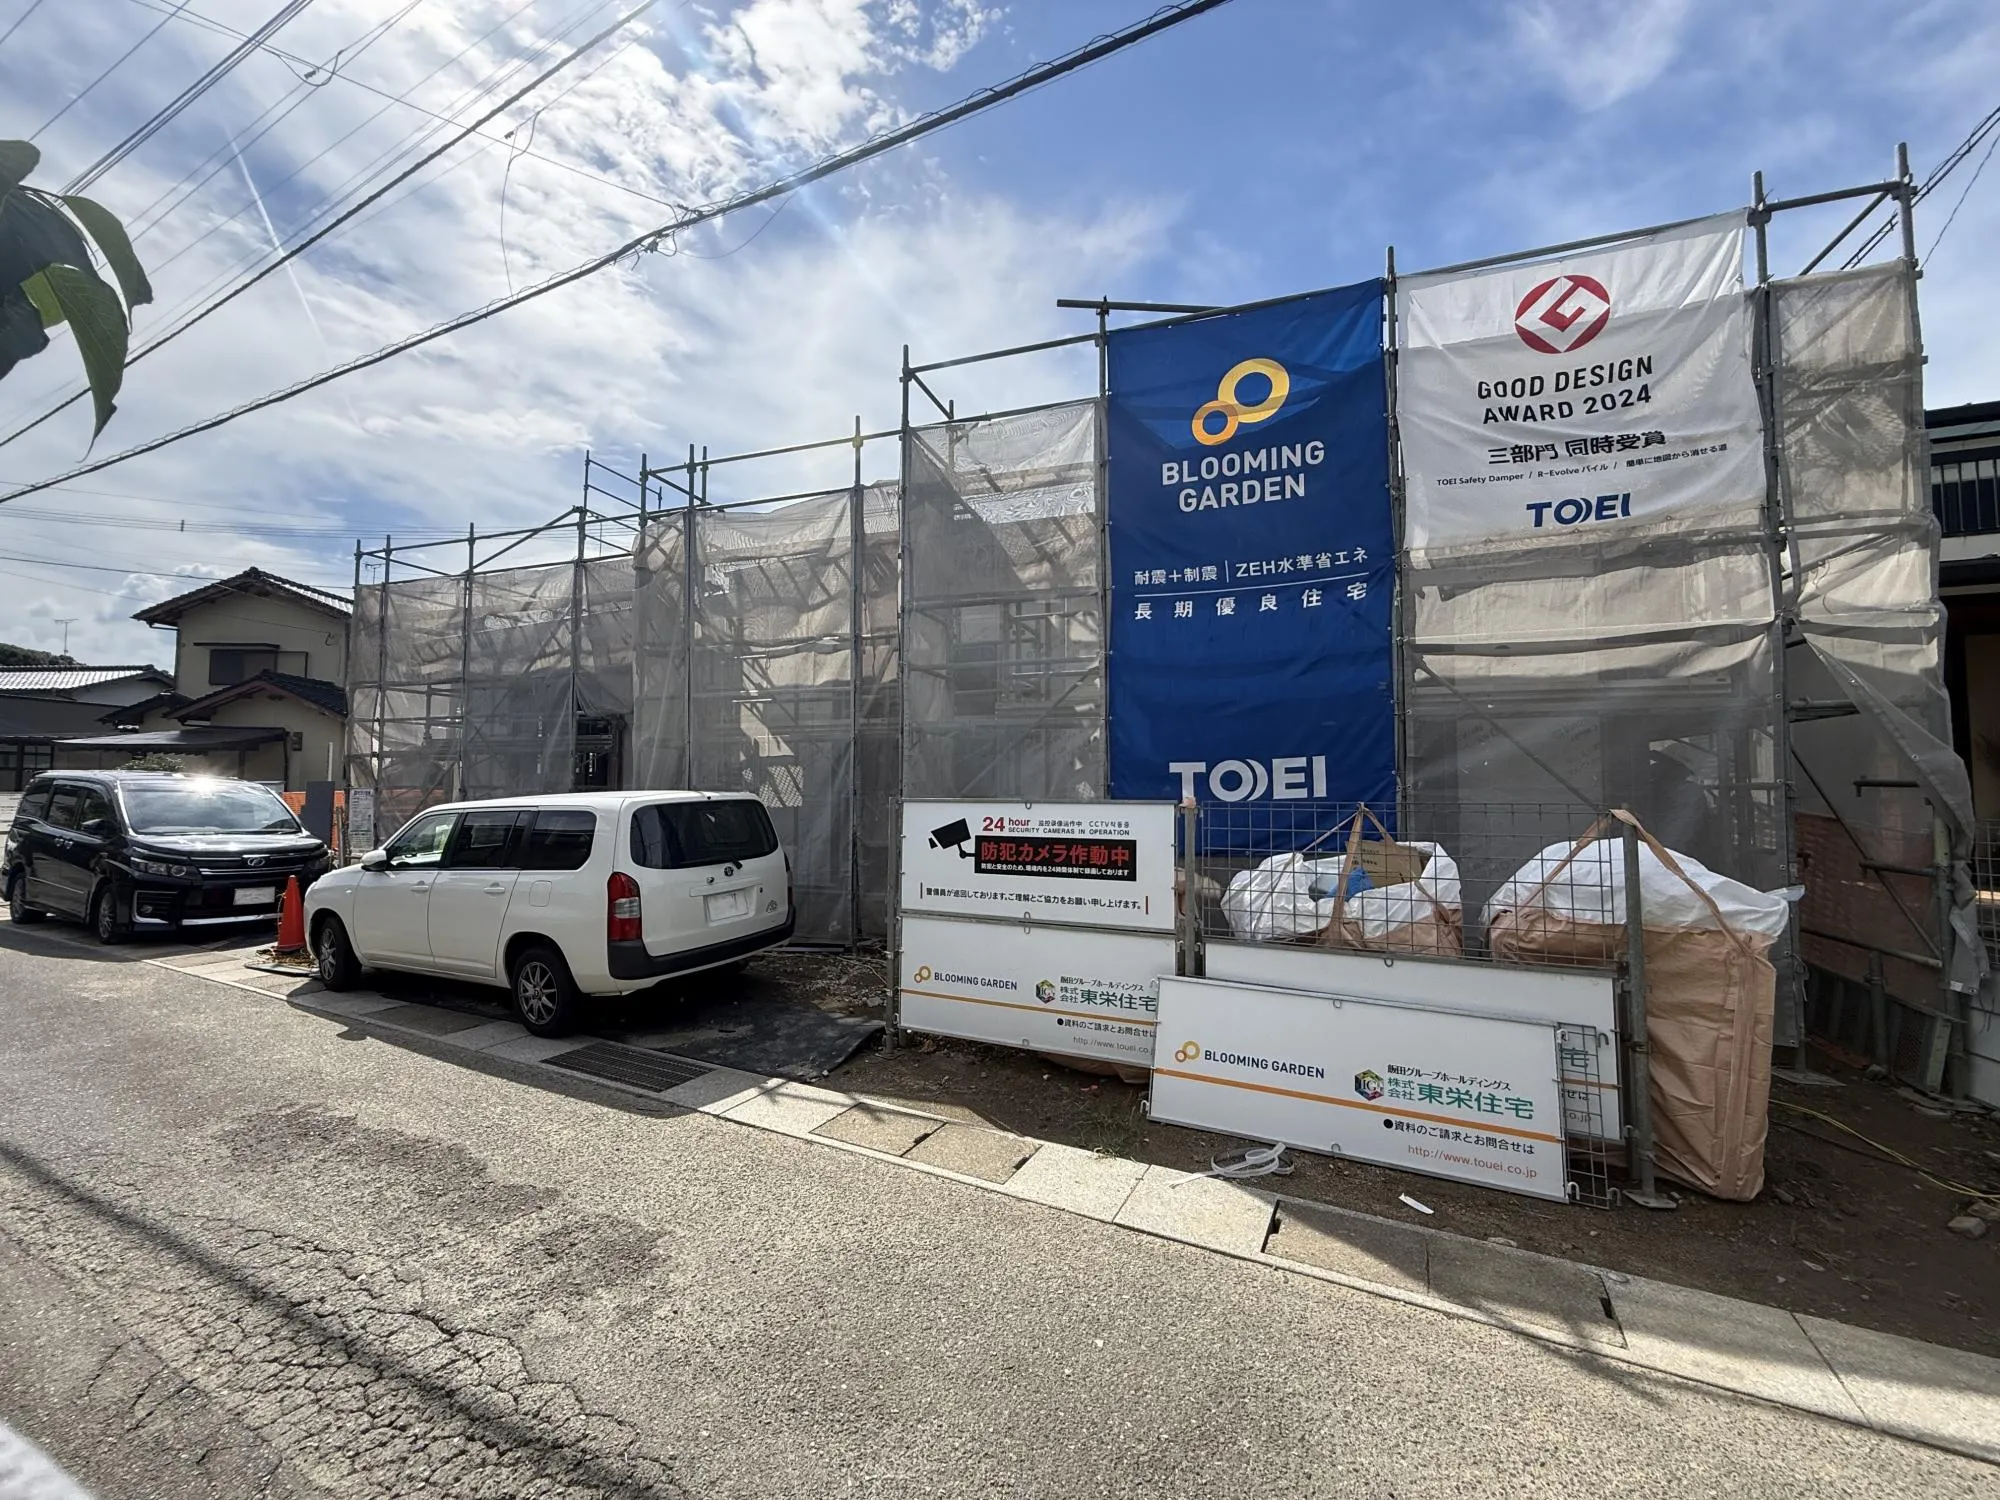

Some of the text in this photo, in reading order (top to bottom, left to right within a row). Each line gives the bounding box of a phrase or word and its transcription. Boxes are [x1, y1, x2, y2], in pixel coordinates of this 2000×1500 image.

[1477, 355, 1653, 401] GOOD DESIGN
[1483, 383, 1652, 424] AWARD 2024
[1162, 440, 1325, 485] BLOOMING
[1488, 430, 1667, 465] 三部門 同時受賞
[1437, 478, 1457, 486] TOEI
[1459, 476, 1486, 485] Safety
[1489, 473, 1524, 482] Damper
[1537, 466, 1580, 478] R-Evolve
[1179, 473, 1305, 513] GARDEN
[1526, 493, 1631, 527] TOEI
[1236, 547, 1368, 578] ZEH水準省エネ
[1169, 755, 1327, 802] TOEI
[982, 816, 1031, 832] 24 hour
[981, 841, 1130, 867] 防犯カメラ作動中
[934, 972, 1018, 991] BLOOMING GARDEN
[1079, 989, 1157, 1012] 東栄住宅
[1204, 1050, 1325, 1079] BLOOMING GARDEN
[1387, 1064, 1512, 1091] 飯田グループホールディングス
[1416, 1082, 1535, 1120] 東栄住宅
[1408, 1145, 1537, 1178] http://www.touei.co.jp
